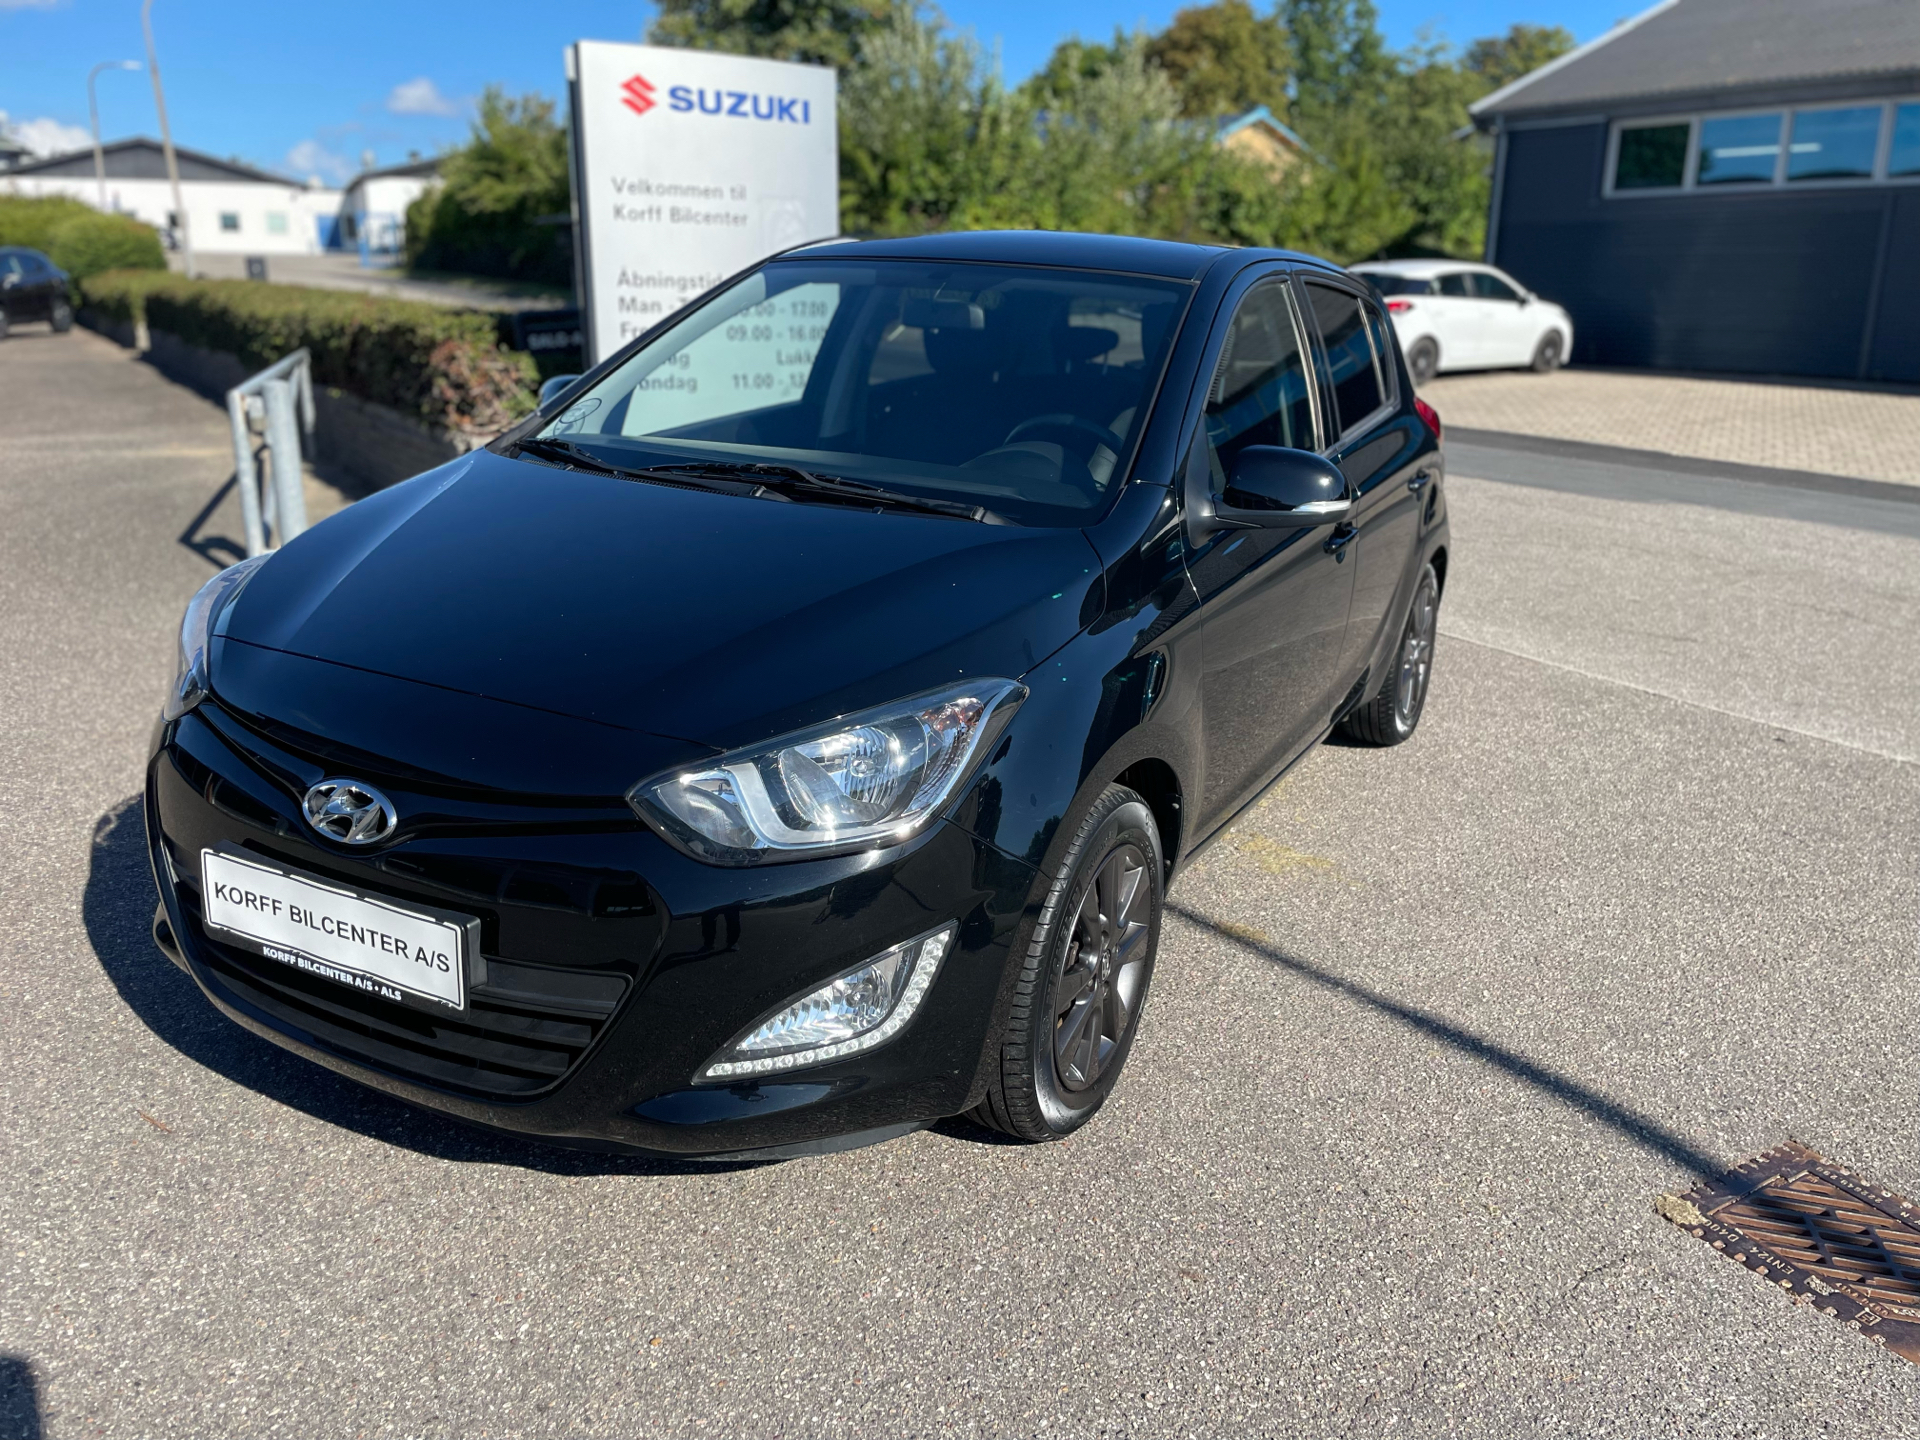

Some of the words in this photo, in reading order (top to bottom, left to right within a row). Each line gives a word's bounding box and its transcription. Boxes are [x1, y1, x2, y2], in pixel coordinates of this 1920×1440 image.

[668, 85, 811, 124] SUZUKI
[611, 177, 724, 201] Velkommen
[730, 184, 748, 201] til
[612, 204, 662, 223] Korff
[669, 206, 749, 228] Bilcenter
[618, 296, 662, 314] Man
[726, 325, 774, 342] 09.00
[732, 372, 774, 390] 11.00
[214, 881, 283, 916] KORFF
[289, 904, 409, 960] BILCENTER
[414, 946, 450, 973] A/S
[262, 946, 296, 966] KORFF
[297, 957, 354, 985] BILCENTER
[355, 977, 373, 991] A/S
[380, 986, 402, 1001] ALS
[1749, 1246, 1795, 1275] EN124
